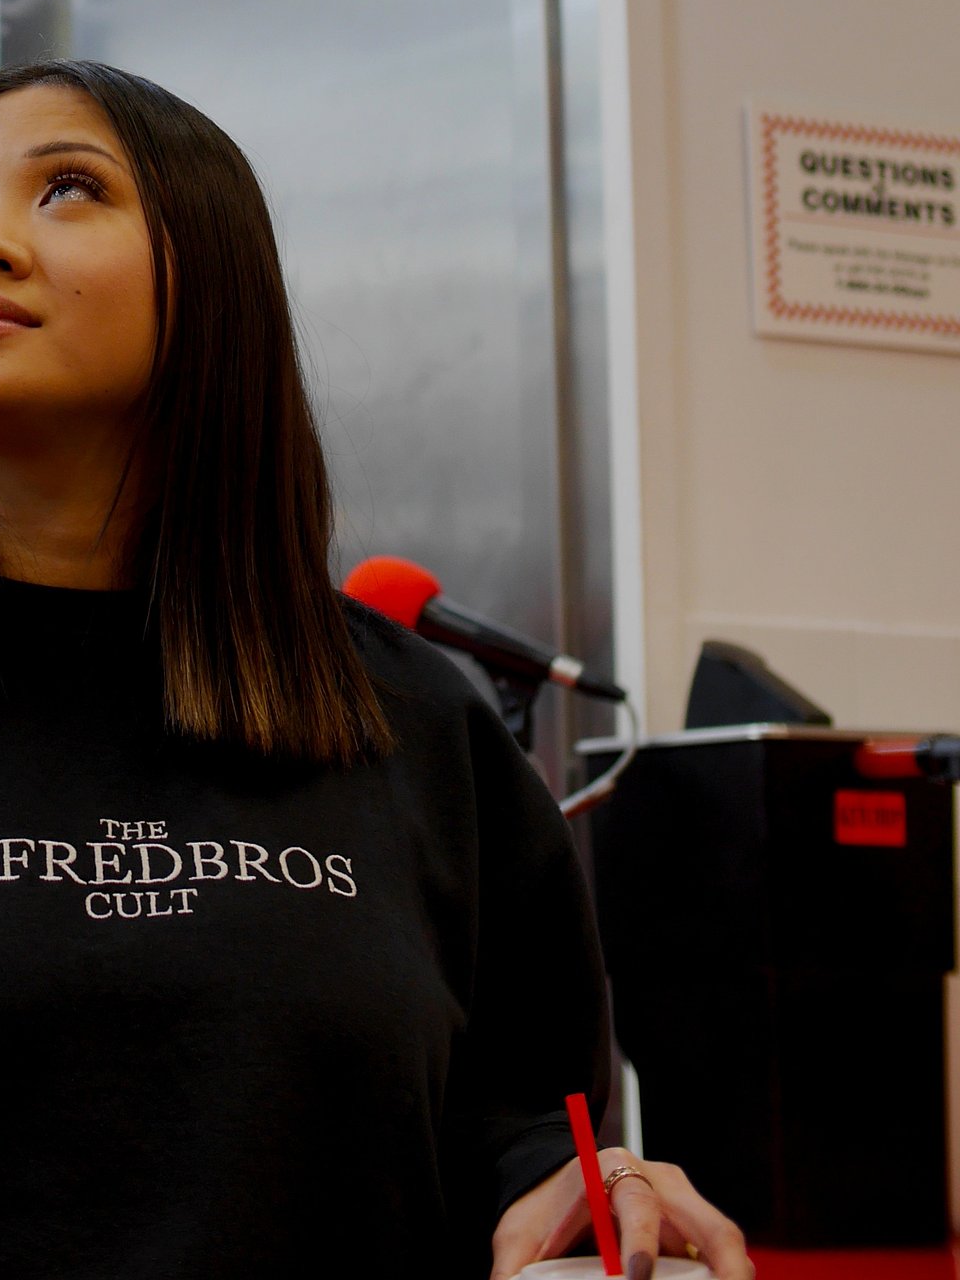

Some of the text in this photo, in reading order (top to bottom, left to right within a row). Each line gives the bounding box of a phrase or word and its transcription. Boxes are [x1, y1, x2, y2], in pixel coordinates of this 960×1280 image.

[800, 150, 954, 190] QUESTIONS
[802, 187, 954, 226] COMMENTS
[99, 818, 169, 840] THE
[85, 888, 198, 919] CULT
